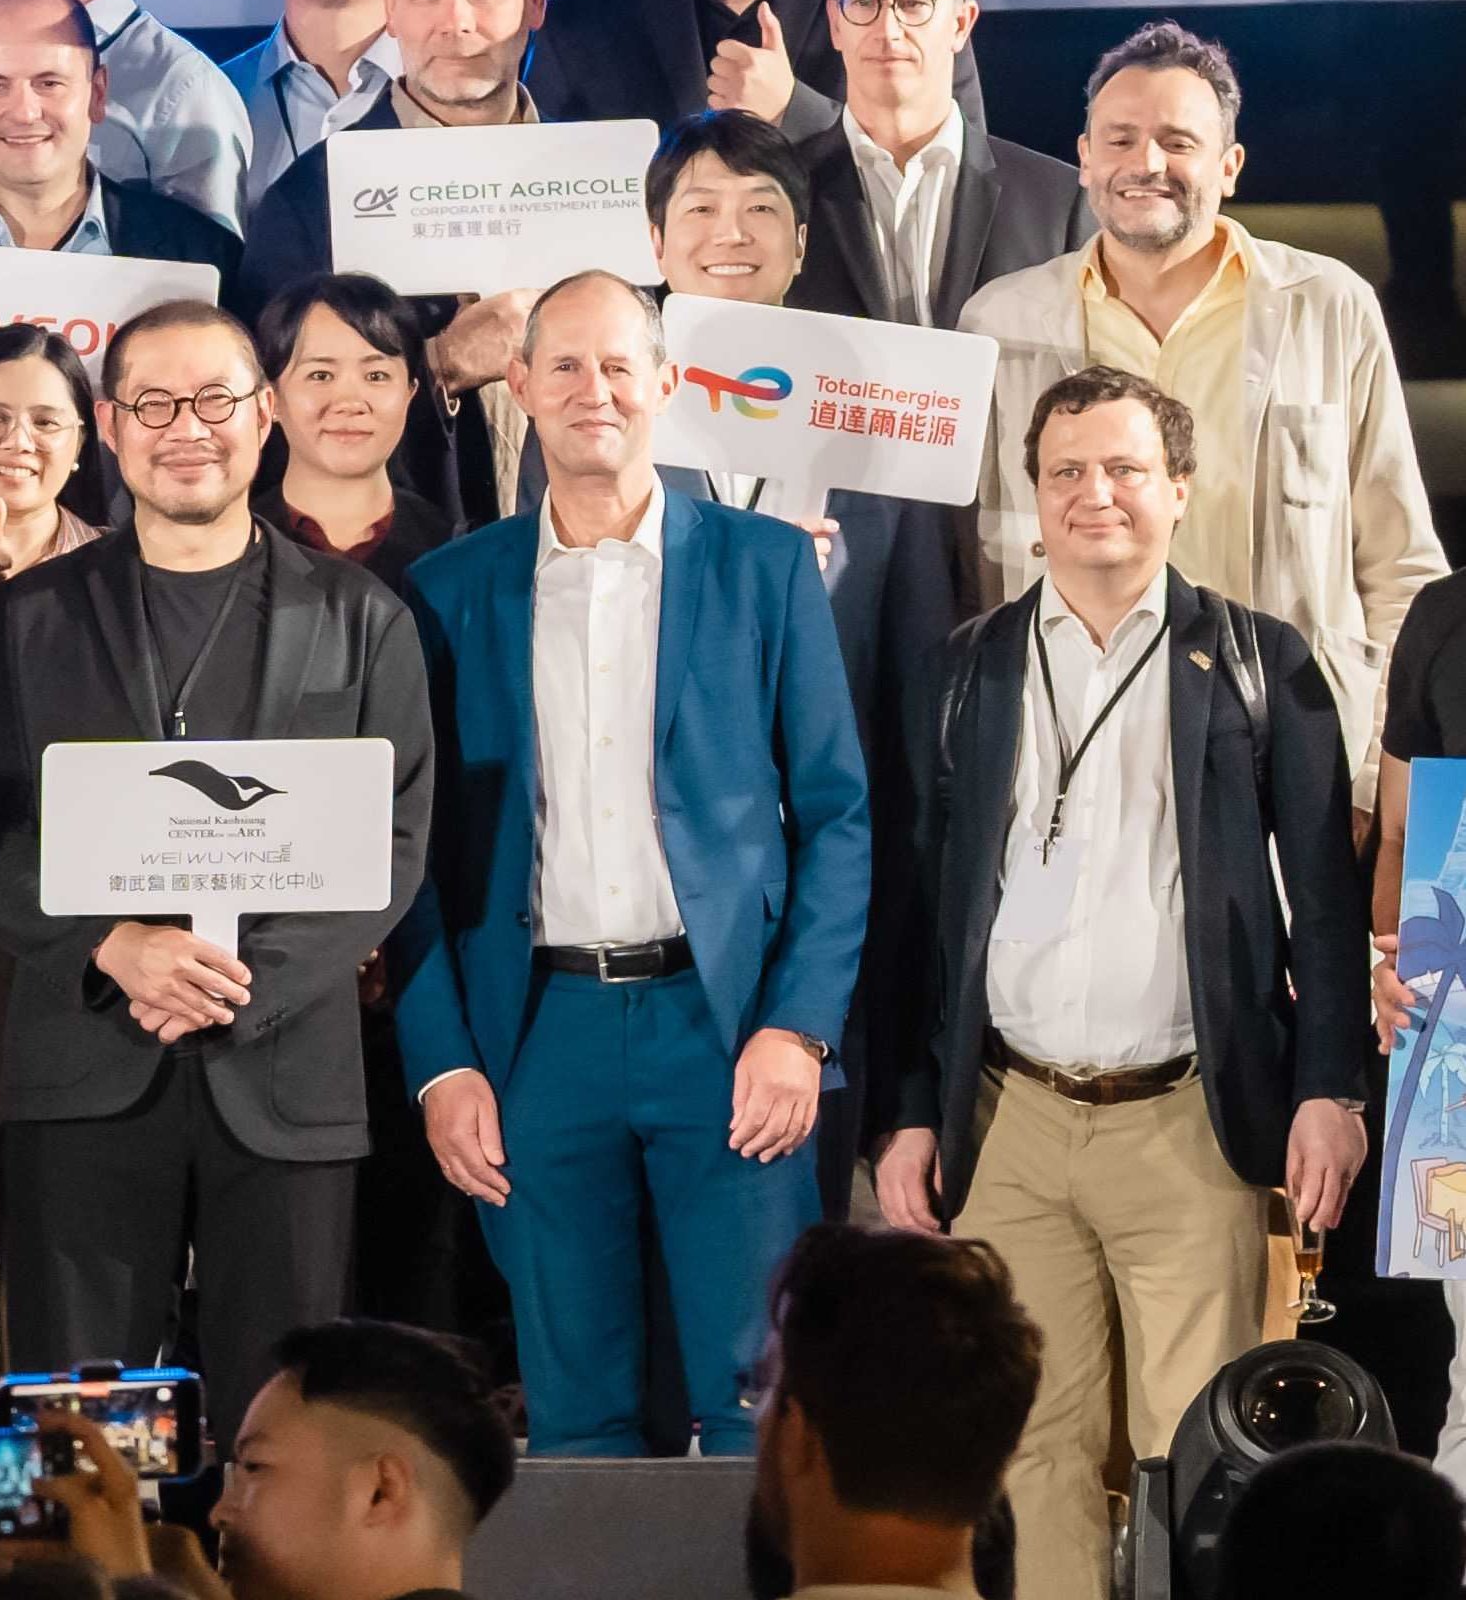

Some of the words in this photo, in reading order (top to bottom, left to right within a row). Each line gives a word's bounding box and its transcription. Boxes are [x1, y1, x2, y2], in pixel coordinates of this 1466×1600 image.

[409, 181, 501, 201] CRÉDIT
[510, 177, 639, 198] AGRICOLE
[410, 204, 495, 217] CORPORATE
[510, 201, 598, 213] INVESTMENT
[602, 199, 640, 210] BANK
[814, 374, 962, 411] TotalEnergies
[807, 399, 958, 447] 道達爾能源
[169, 816, 212, 826] National
[214, 816, 267, 827] Kaohsiung
[168, 829, 214, 839] CENTER
[171, 871, 325, 892] 國家藝術文化中心
